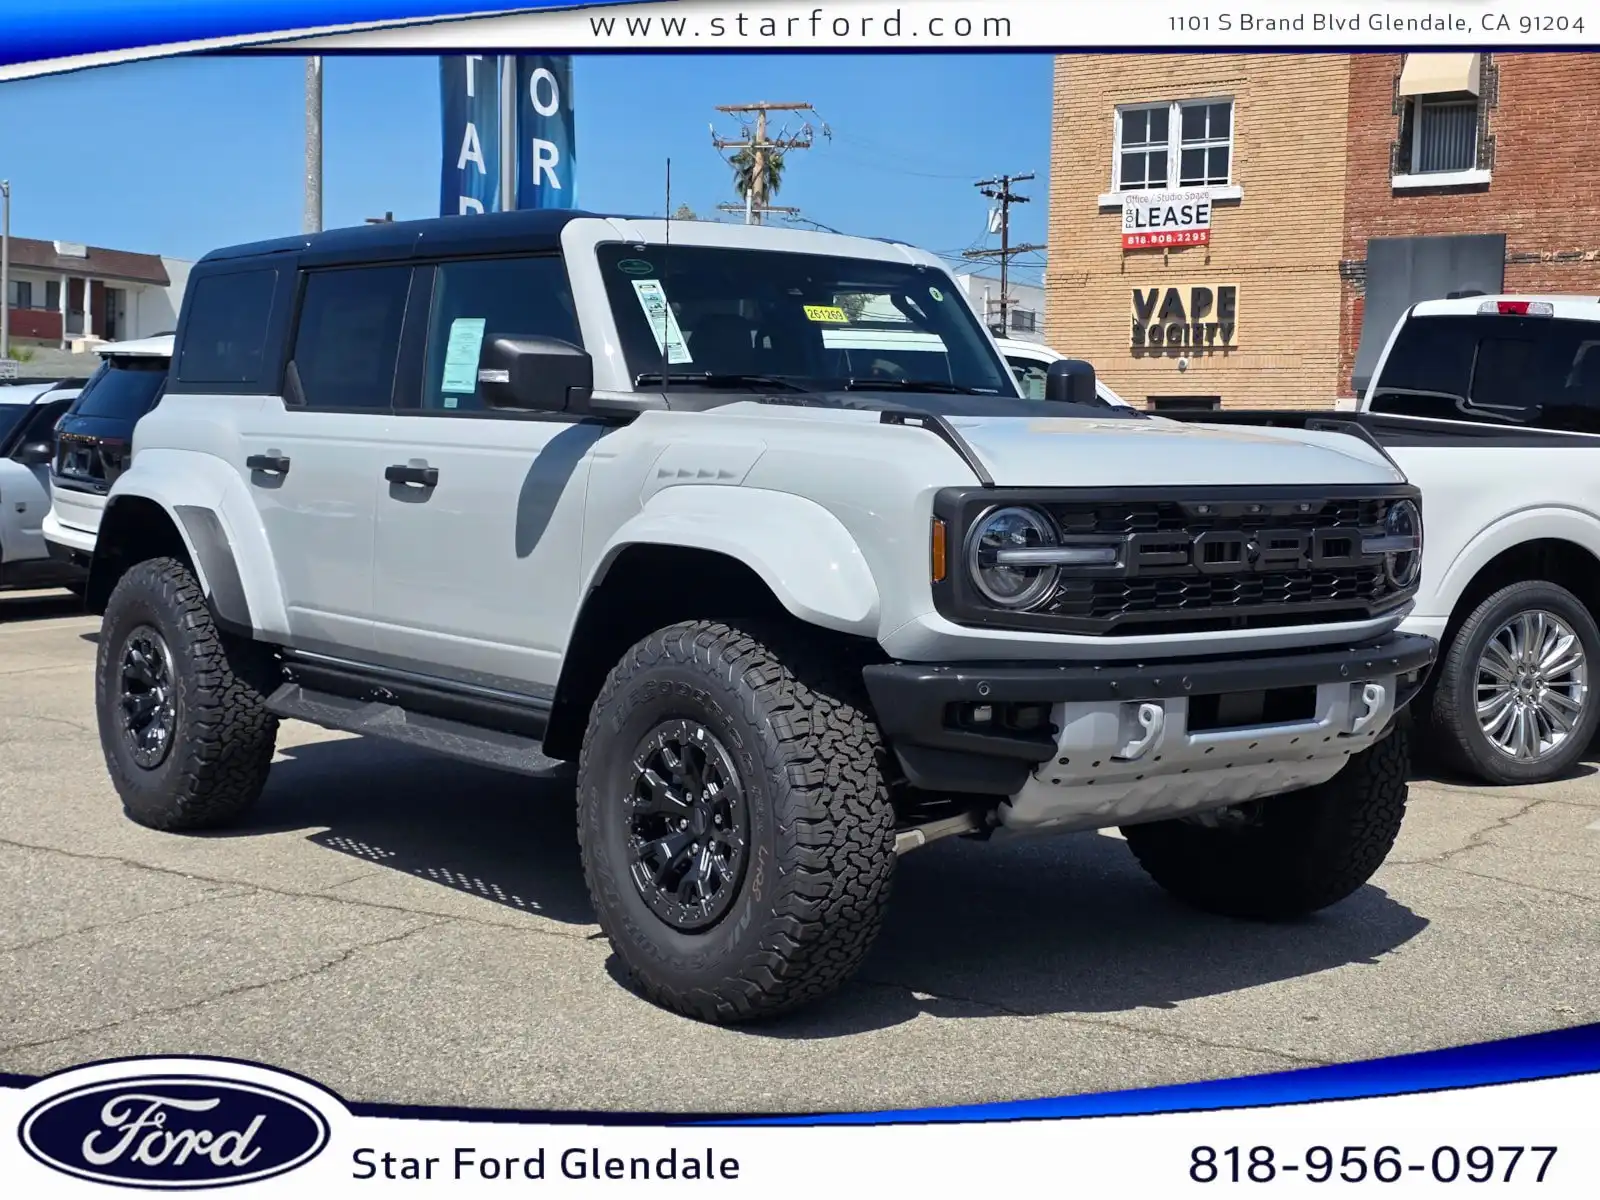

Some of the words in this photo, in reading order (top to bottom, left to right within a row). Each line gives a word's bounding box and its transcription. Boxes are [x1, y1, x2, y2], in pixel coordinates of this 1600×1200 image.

[1125, 194, 1149, 204] Office
[1157, 192, 1183, 202] Studio
[1184, 191, 1210, 203] Space
[1125, 208, 1134, 229] FOR
[1135, 203, 1209, 228] LEASE
[807, 309, 844, 320] 261269
[1132, 286, 1236, 319] VAPE
[1131, 321, 1235, 346] SOCIETY
[1126, 529, 1363, 578] FORD
